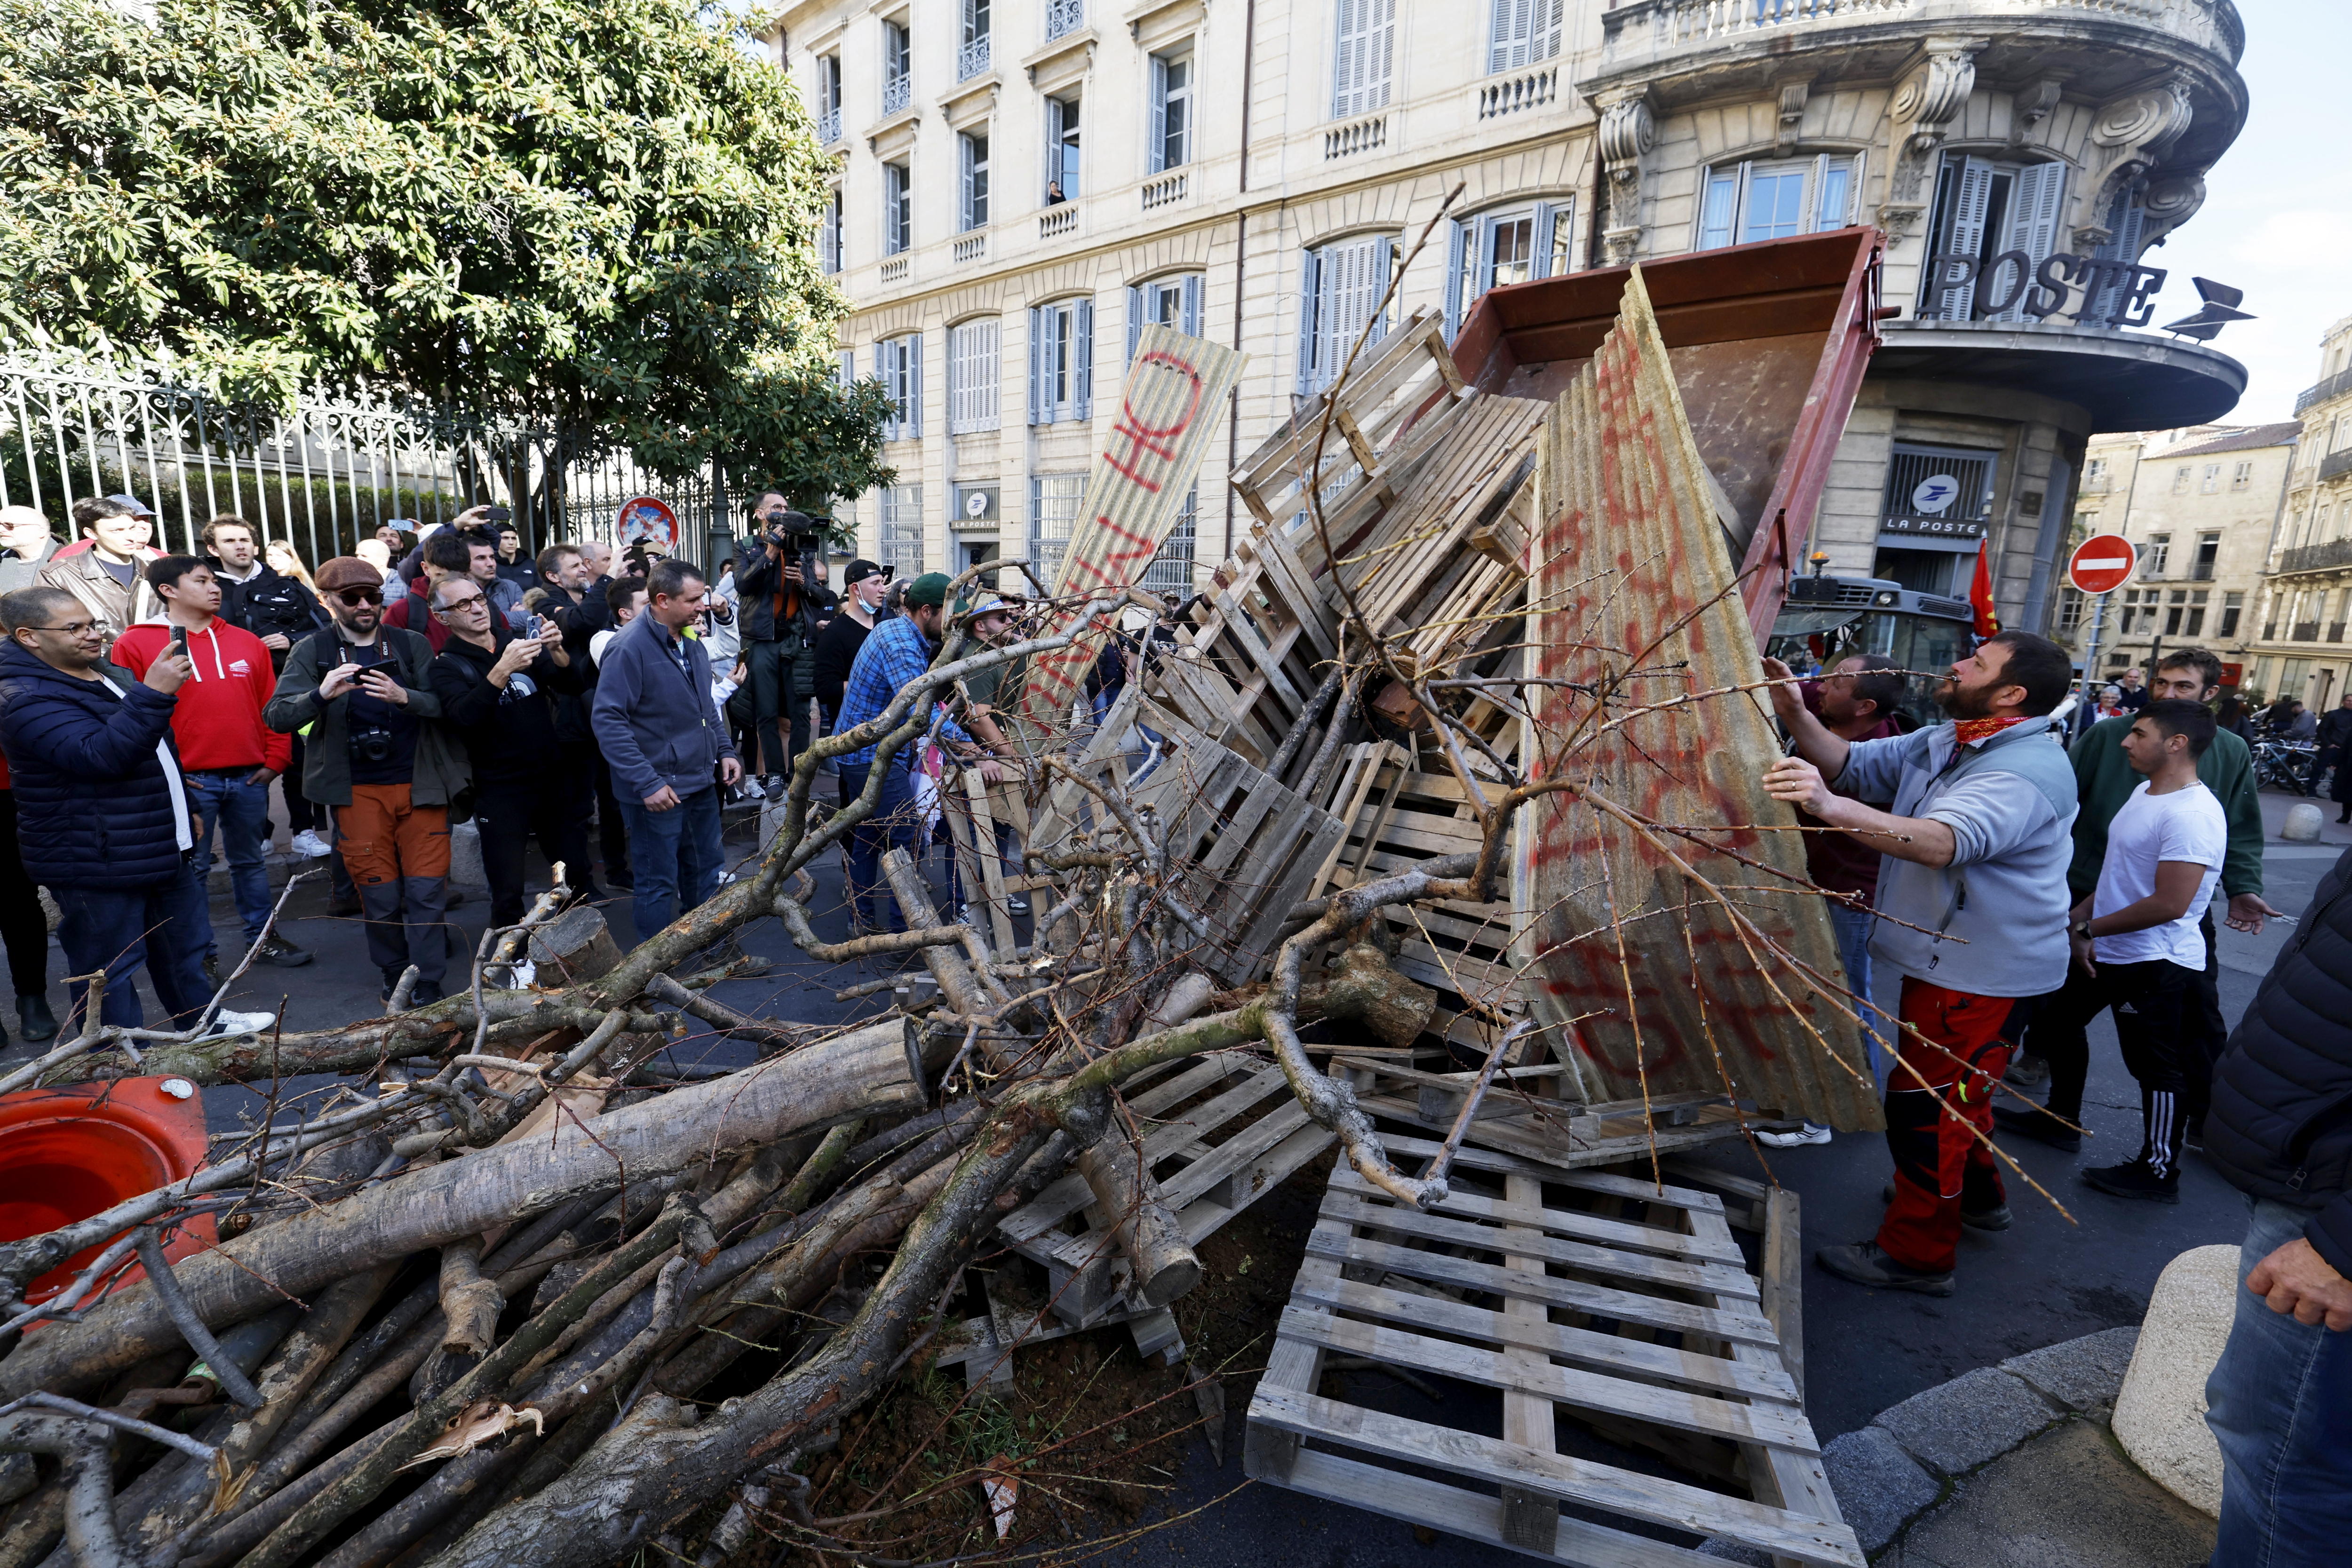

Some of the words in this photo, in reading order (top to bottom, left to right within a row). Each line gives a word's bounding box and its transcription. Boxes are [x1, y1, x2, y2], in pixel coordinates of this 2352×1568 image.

[1915, 250, 2168, 327] POSTE
[1102, 351, 1202, 493] OH
[1887, 518, 1909, 529] LA
[1919, 521, 1977, 533] POSTE
